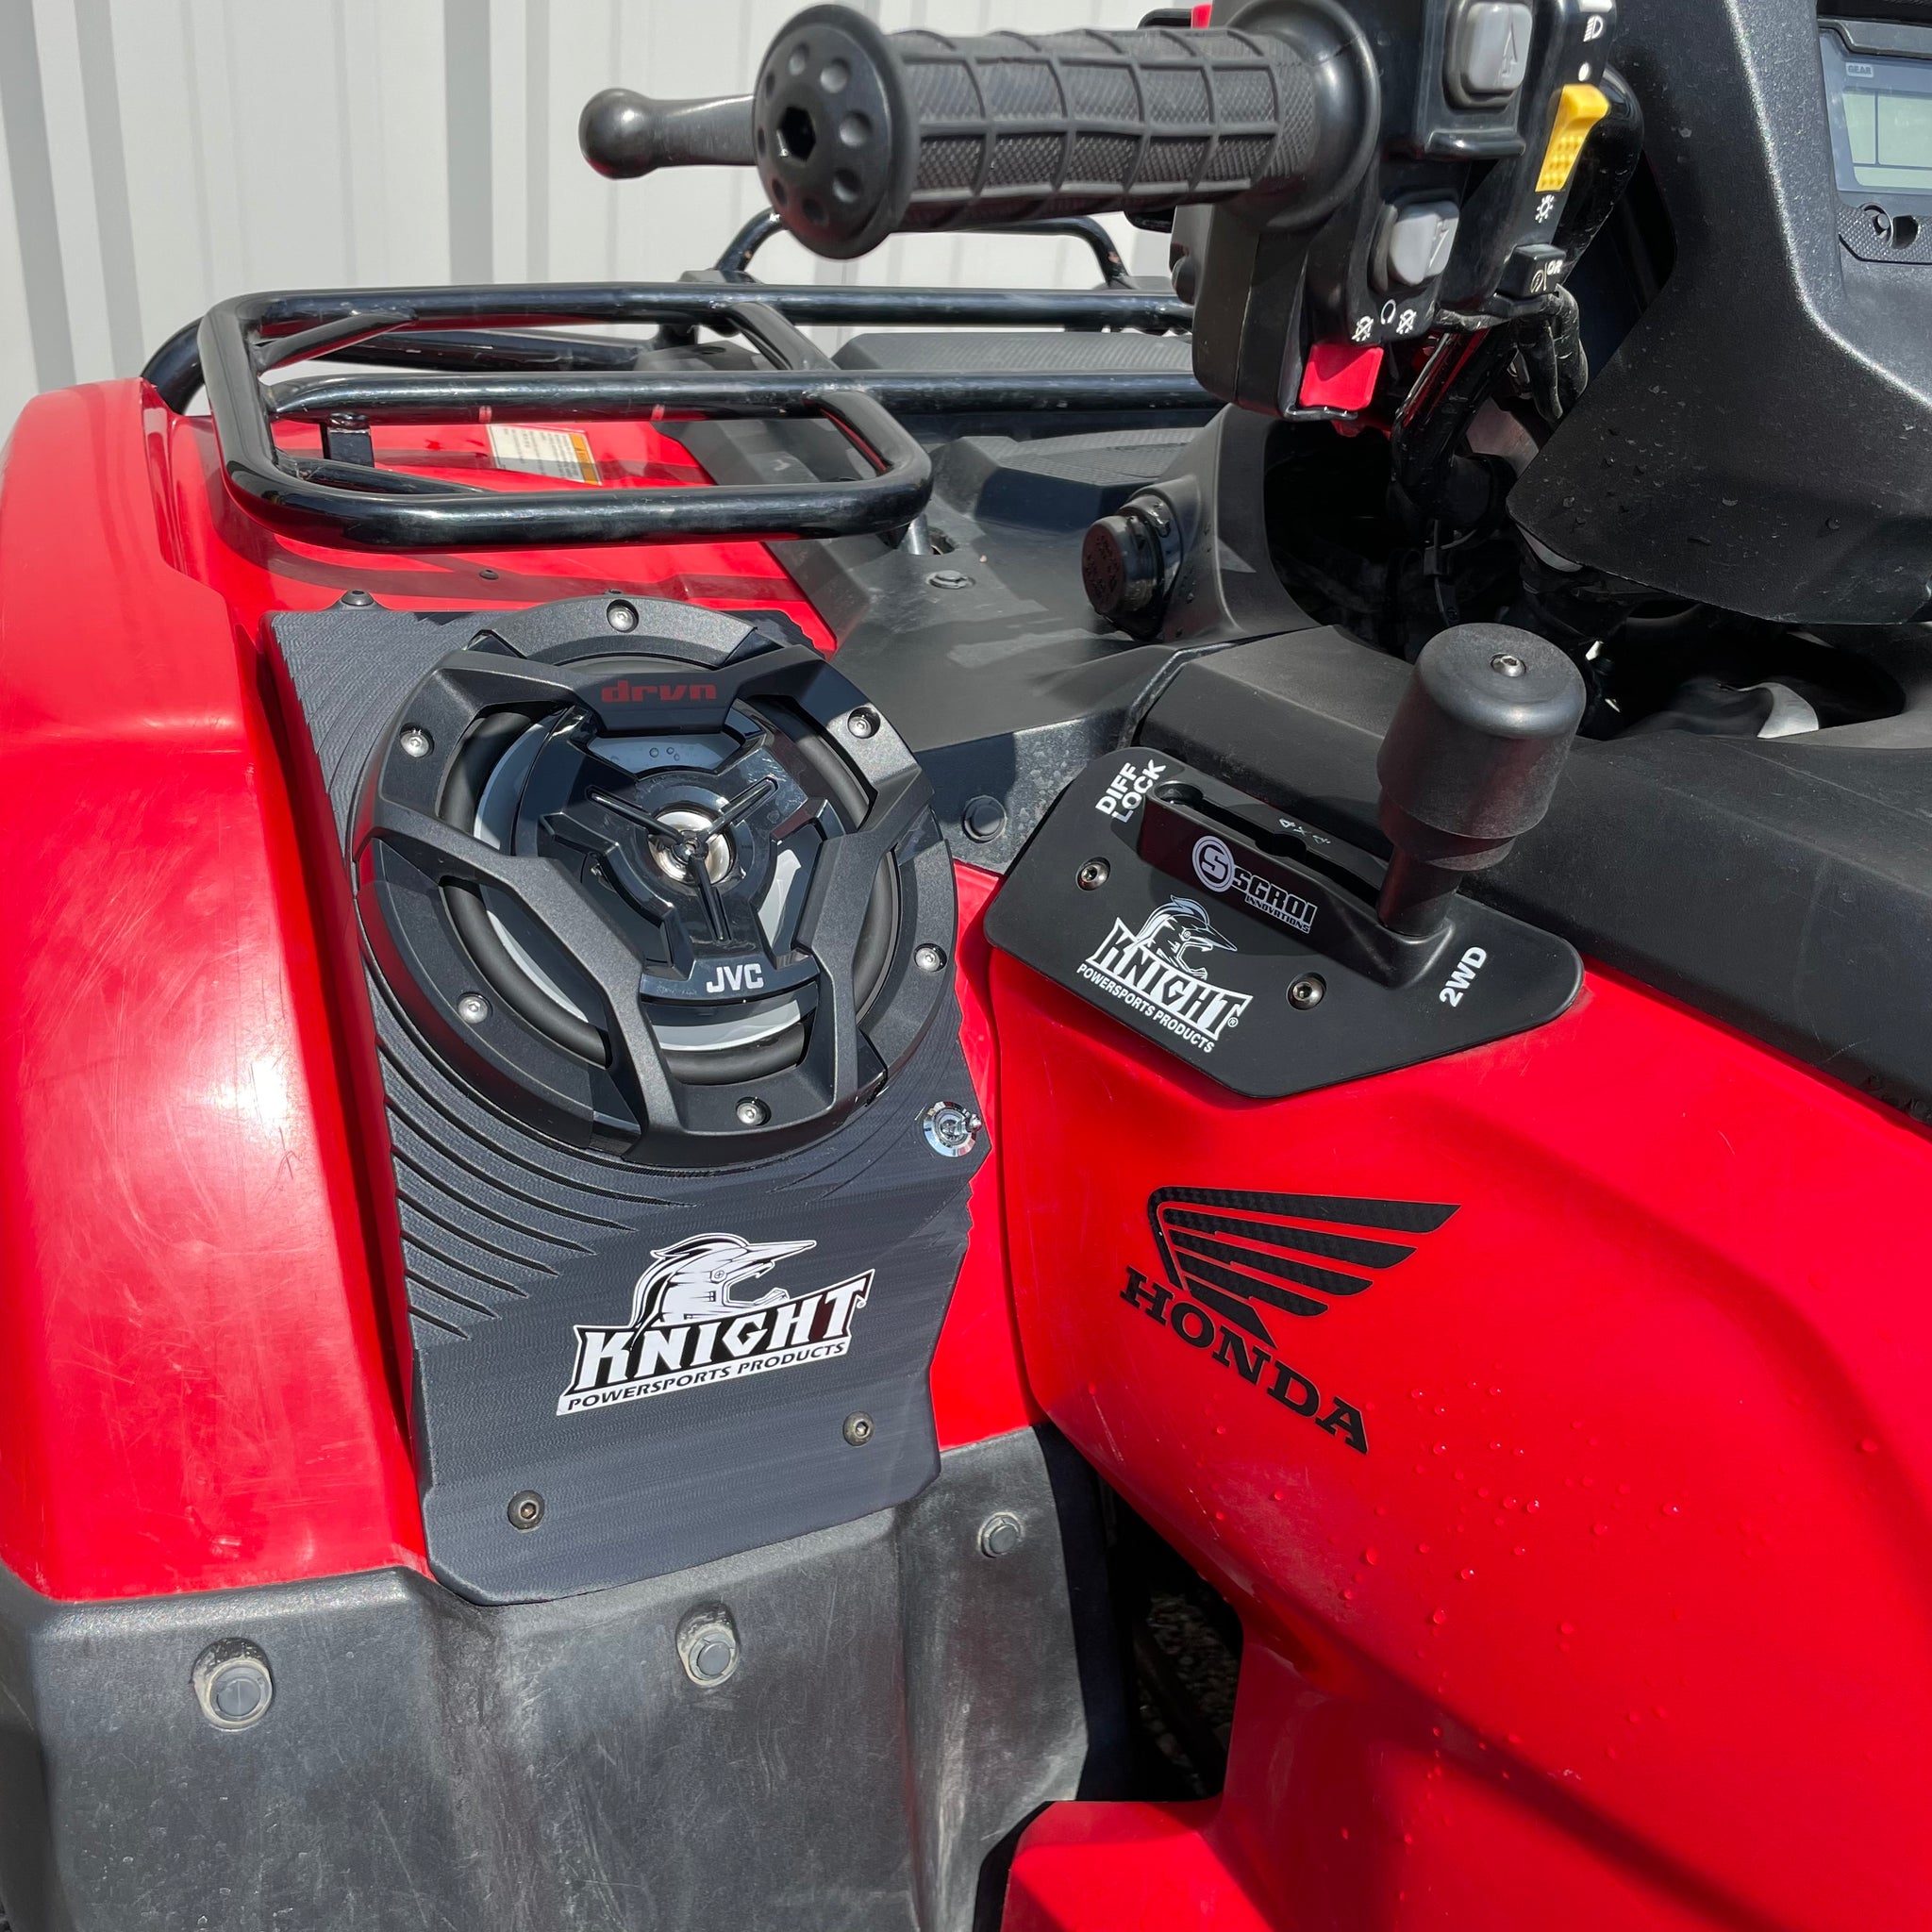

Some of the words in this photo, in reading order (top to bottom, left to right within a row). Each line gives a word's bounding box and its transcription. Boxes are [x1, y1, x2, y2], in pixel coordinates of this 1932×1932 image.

[1847, 64, 1873, 75] GEAR
[601, 679, 717, 703] drvn
[1095, 762, 1138, 815] DIFF
[1111, 758, 1167, 824] LOCK
[1232, 866, 1316, 924] SGROI
[1245, 895, 1310, 933] INNOVATIONS
[707, 963, 764, 993] JVC
[1076, 963, 1156, 1017] POWERSPORTS
[1153, 1008, 1215, 1053] PRODUCTS
[1092, 923, 1248, 1034] KNIGHT
[1439, 946, 1487, 1008] 2WD
[574, 1276, 867, 1390] KNIGHT
[1119, 1265, 1368, 1456] HONDA
[567, 1366, 731, 1411] POWERSPORTS
[737, 1341, 847, 1376] PRODUCTS
